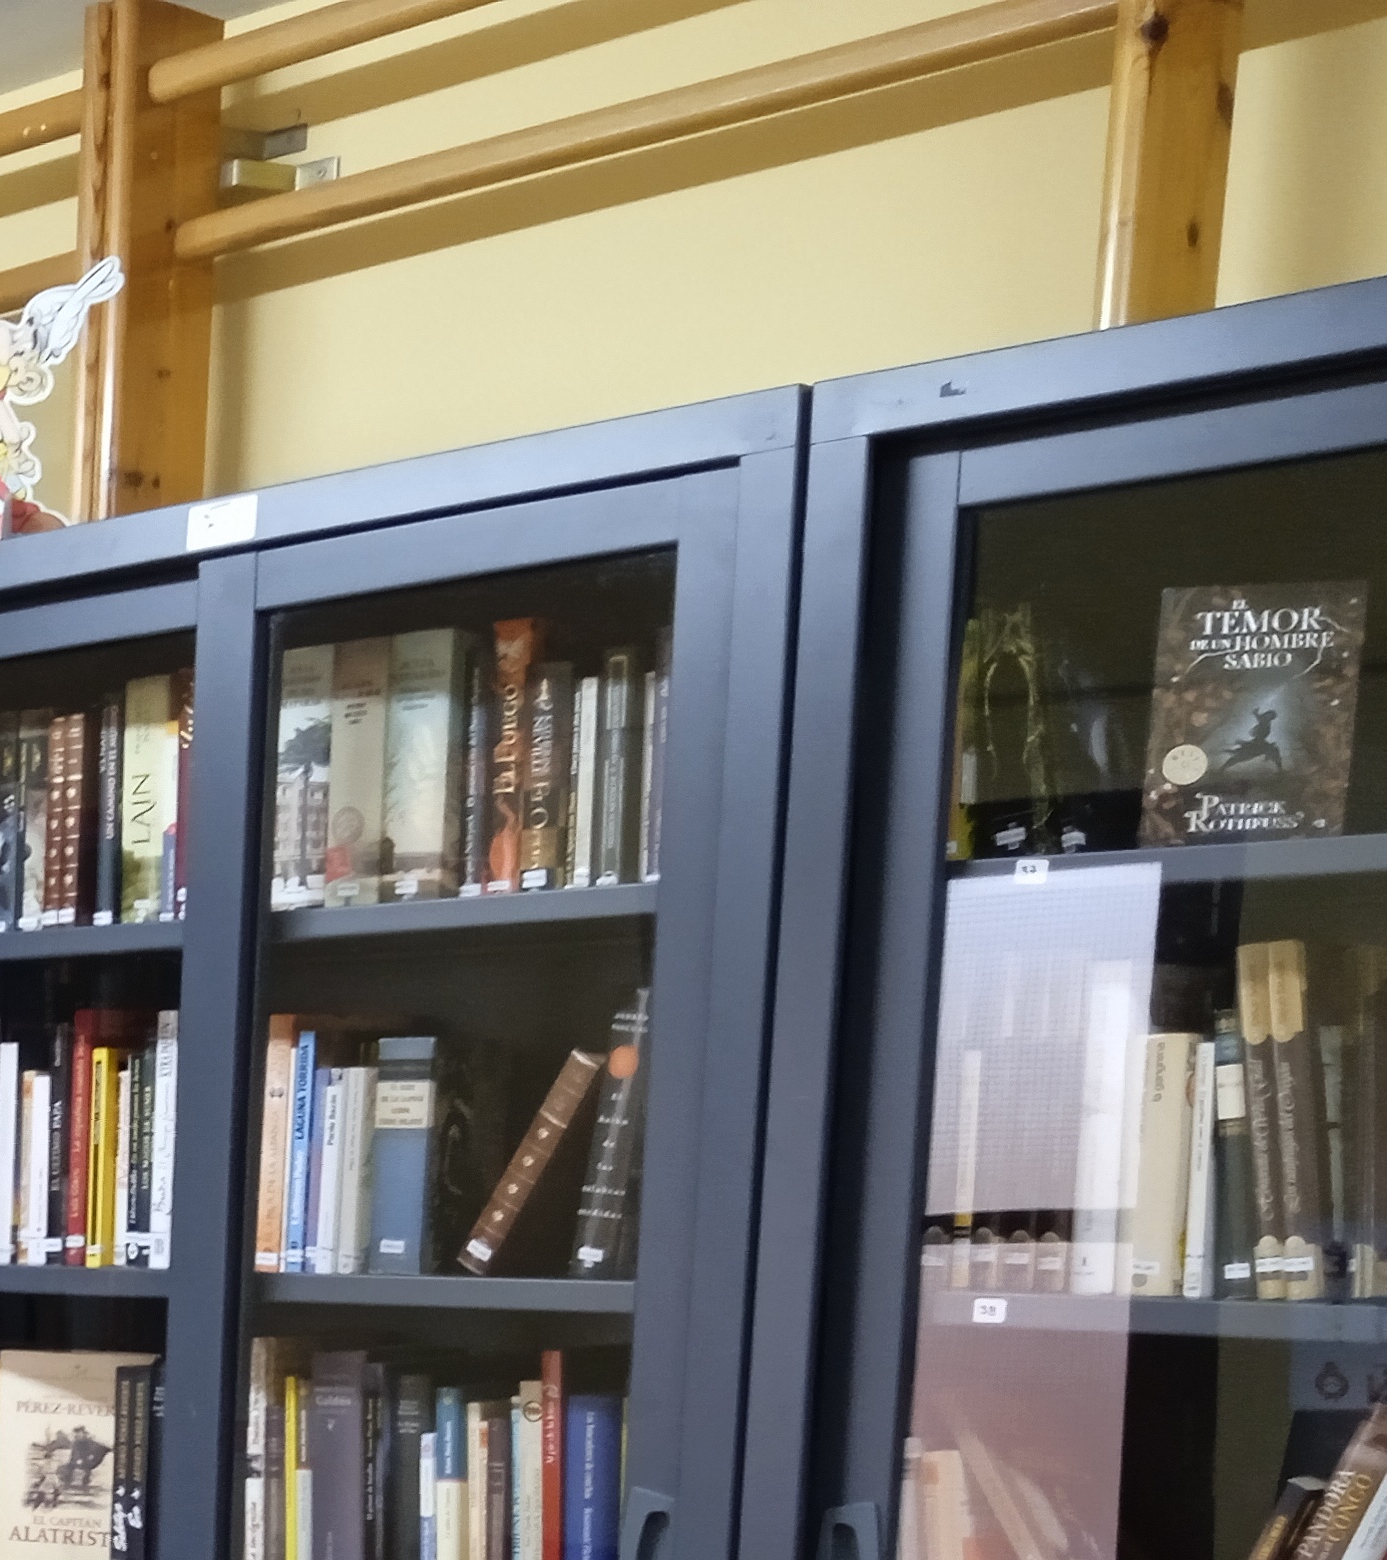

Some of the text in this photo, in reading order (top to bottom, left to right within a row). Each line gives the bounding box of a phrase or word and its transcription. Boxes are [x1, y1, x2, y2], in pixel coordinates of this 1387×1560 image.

[1233, 599, 1249, 610] EL
[1195, 606, 1323, 636] TEMOR
[1234, 632, 1335, 651] HOMBRE
[1223, 652, 1293, 670] SABIO
[495, 685, 518, 765] FUEGO
[1296, 1469, 1356, 1559] PANDORA
[1326, 1472, 1373, 1544] CONGO
